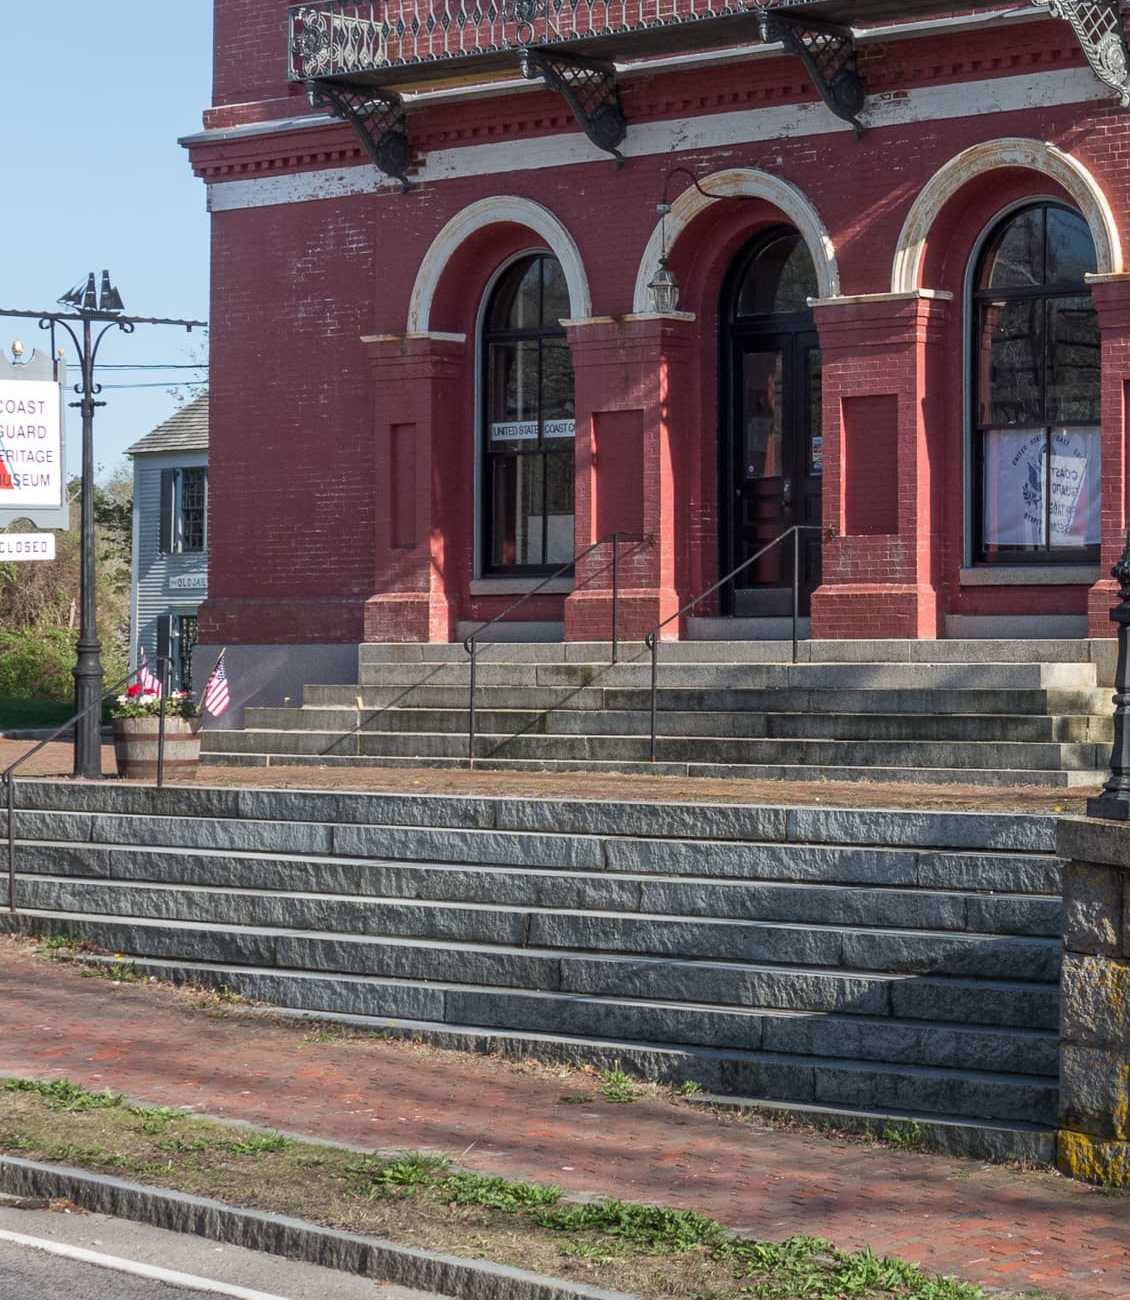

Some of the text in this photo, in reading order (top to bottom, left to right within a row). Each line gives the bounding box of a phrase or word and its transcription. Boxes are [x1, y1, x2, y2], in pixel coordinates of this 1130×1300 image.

[494, 426, 518, 437] UNITED
[518, 424, 539, 435] STATE
[544, 422, 568, 434] COAST
[0, 473, 50, 487] USEUM
[0, 541, 47, 553] CLOSED
